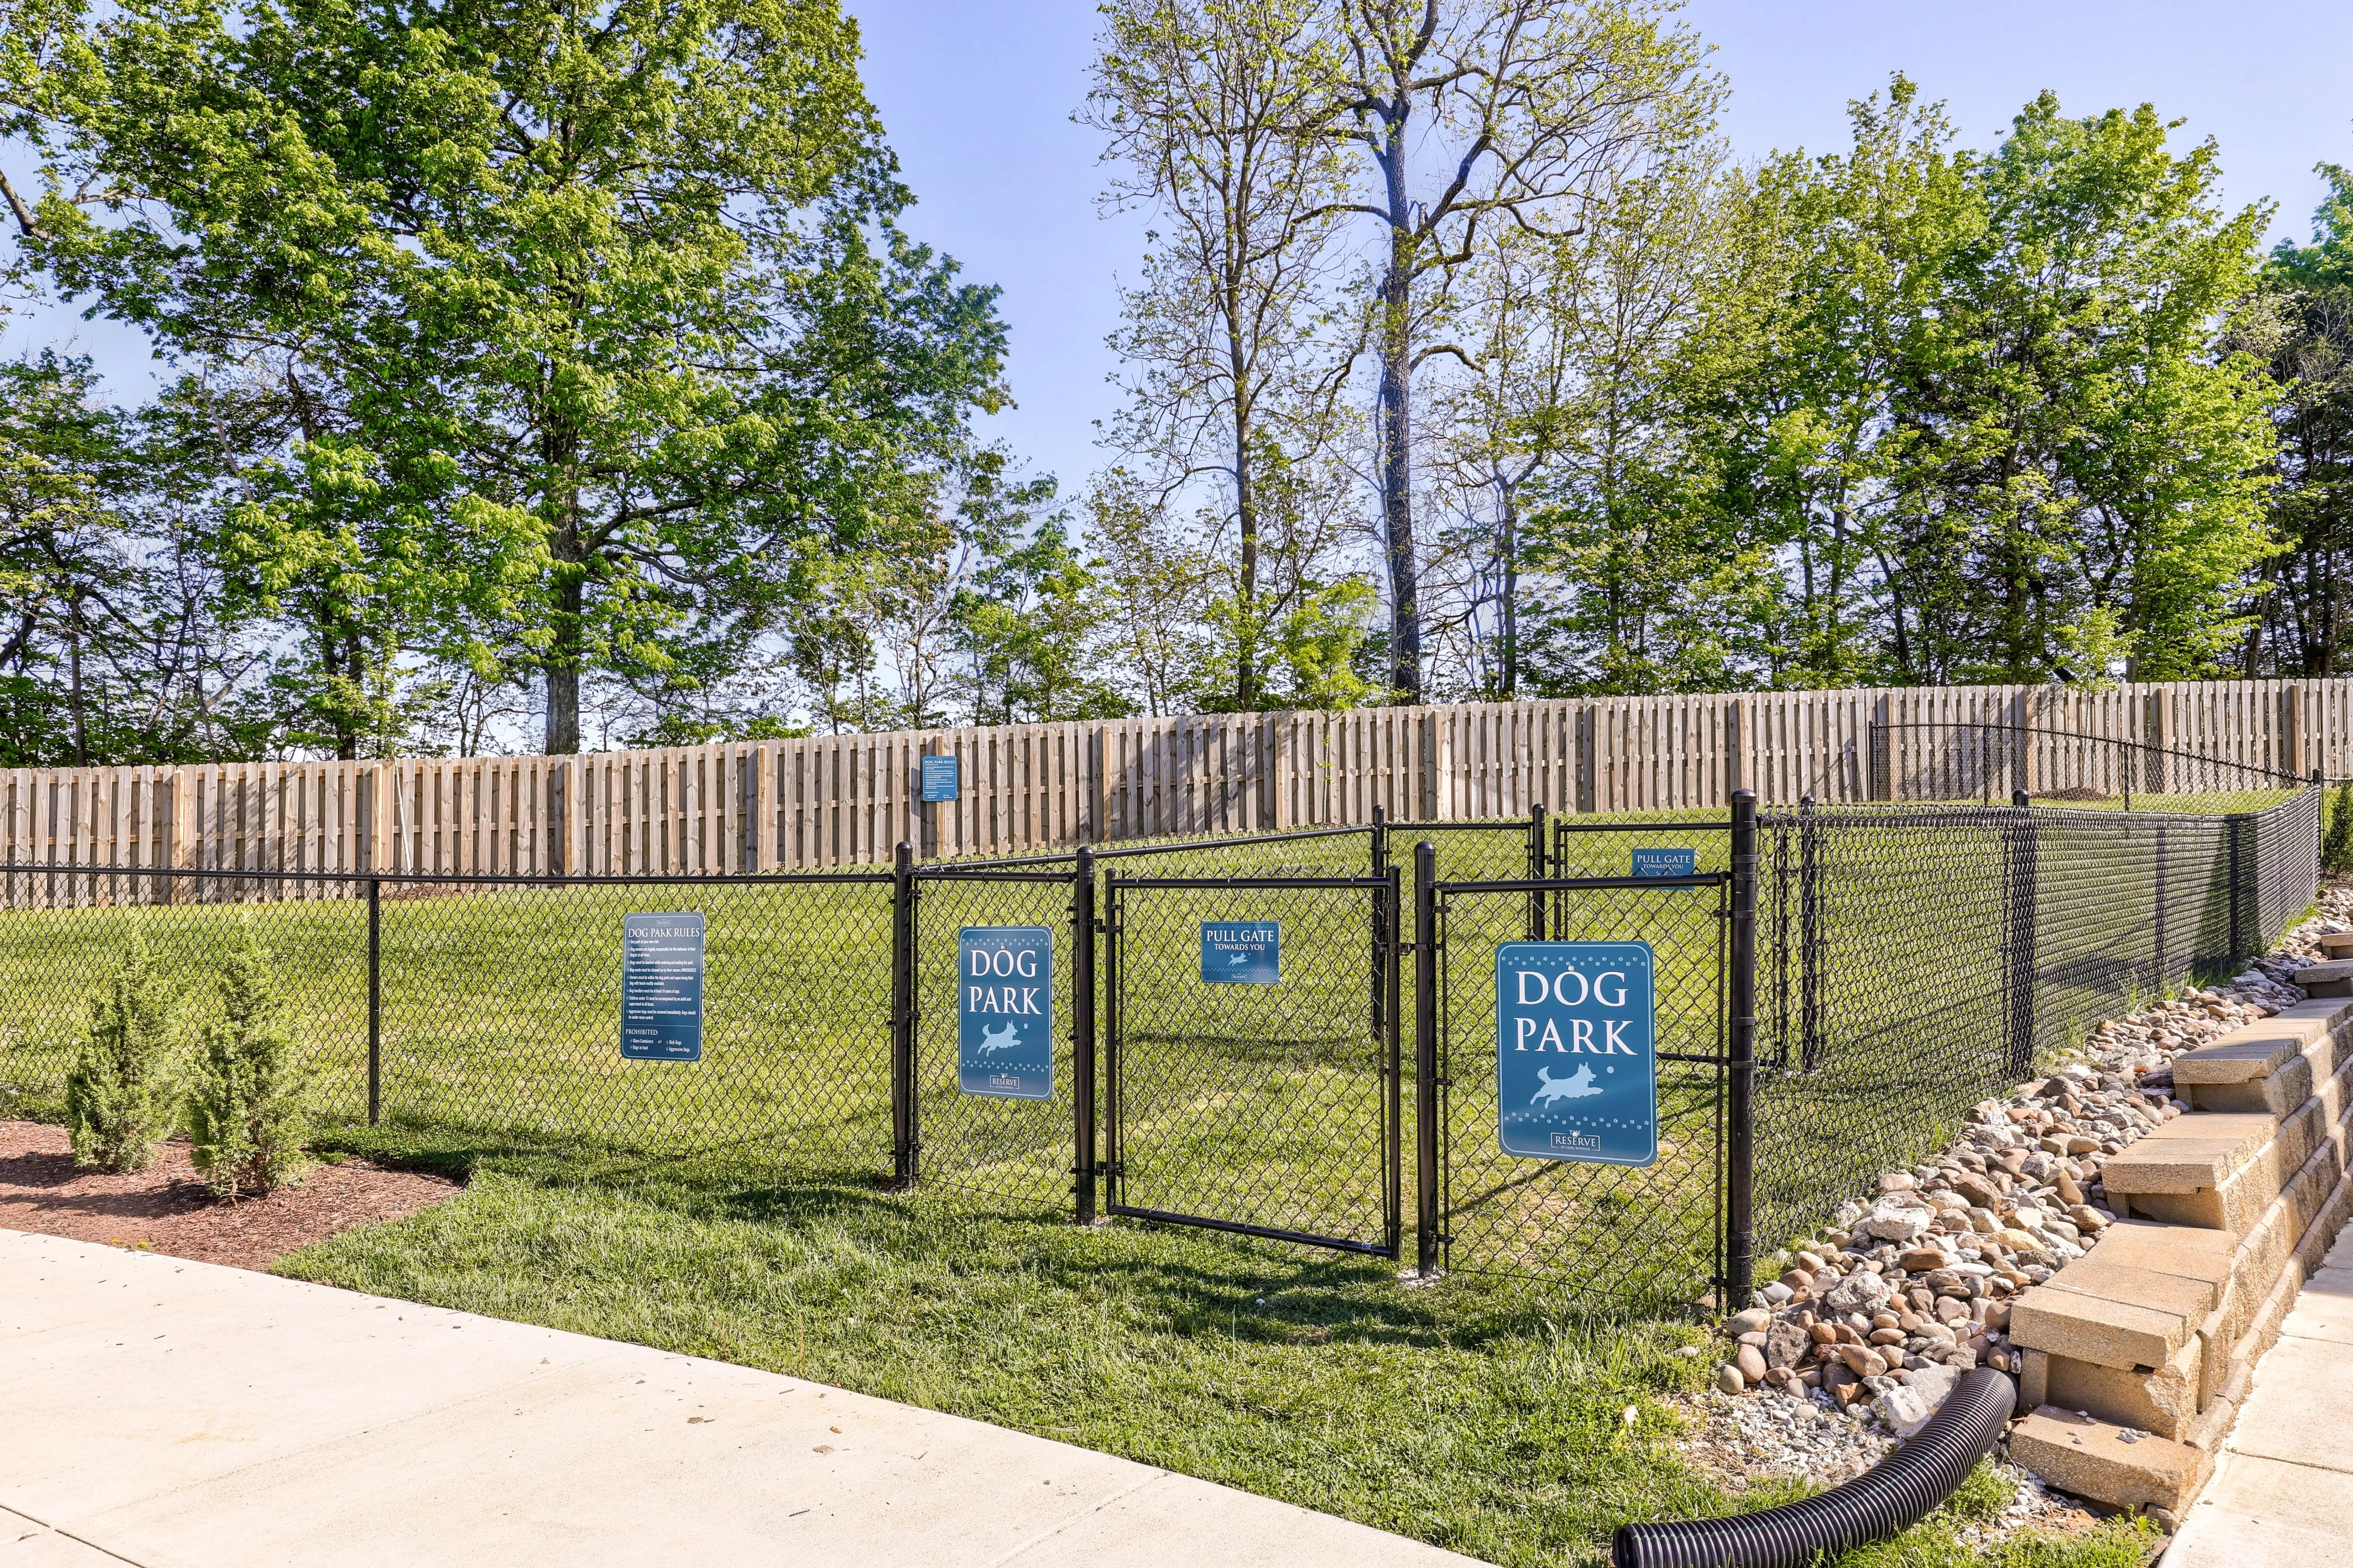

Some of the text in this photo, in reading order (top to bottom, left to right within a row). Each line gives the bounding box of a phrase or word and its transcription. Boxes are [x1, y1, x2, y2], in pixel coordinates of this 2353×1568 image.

[1637, 855, 1691, 863] PULL GATE
[628, 928, 700, 937] DOG PARK RULES
[1206, 930, 1274, 942] PULL GATE
[970, 949, 1037, 977] DOG
[1515, 971, 1629, 1007] DOG
[969, 986, 1043, 1015] PARK
[1514, 1017, 1638, 1056] PARK
[993, 1077, 1017, 1086] RESERVE
[1555, 1136, 1596, 1147] RESERVE
